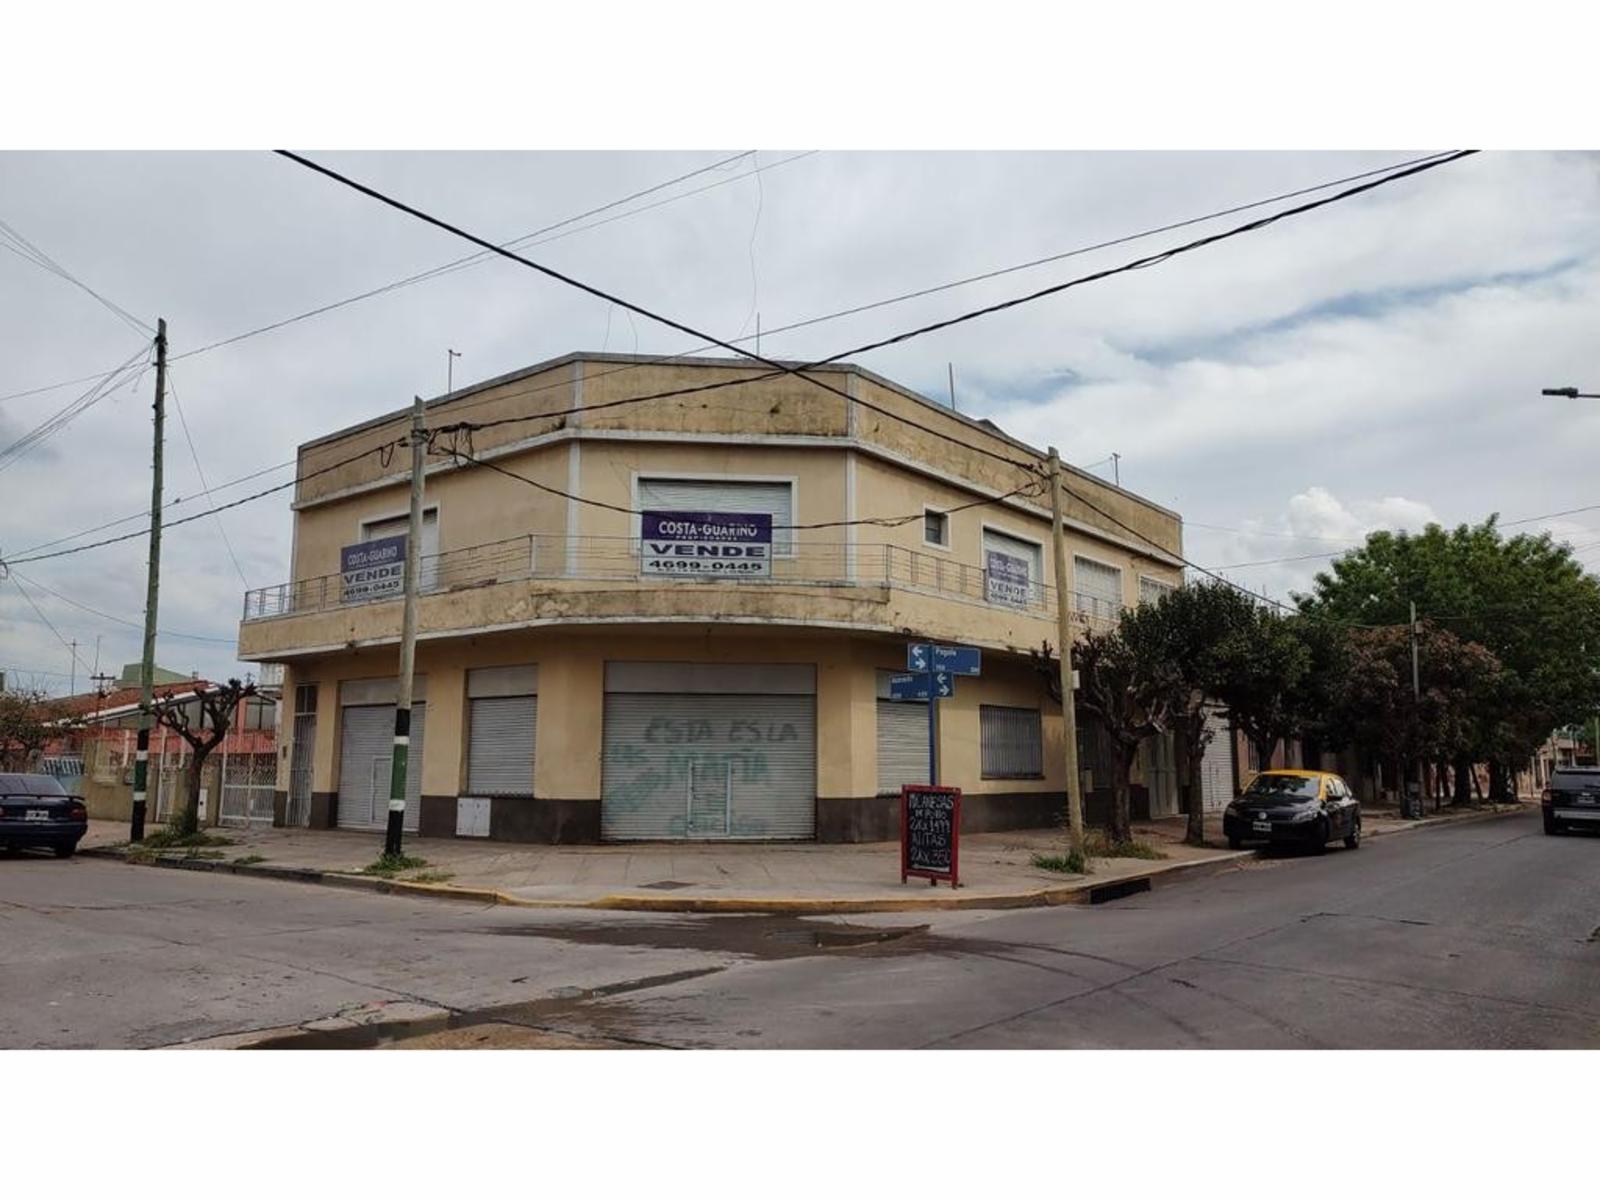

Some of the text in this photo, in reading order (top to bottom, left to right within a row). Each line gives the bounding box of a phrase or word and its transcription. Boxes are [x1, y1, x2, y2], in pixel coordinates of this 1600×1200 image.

[649, 543, 765, 557] VENDE
[648, 560, 762, 571] 4699-0445
[343, 565, 401, 584] VENDE
[990, 580, 1025, 596] VENDE
[645, 716, 713, 745] ESTA
